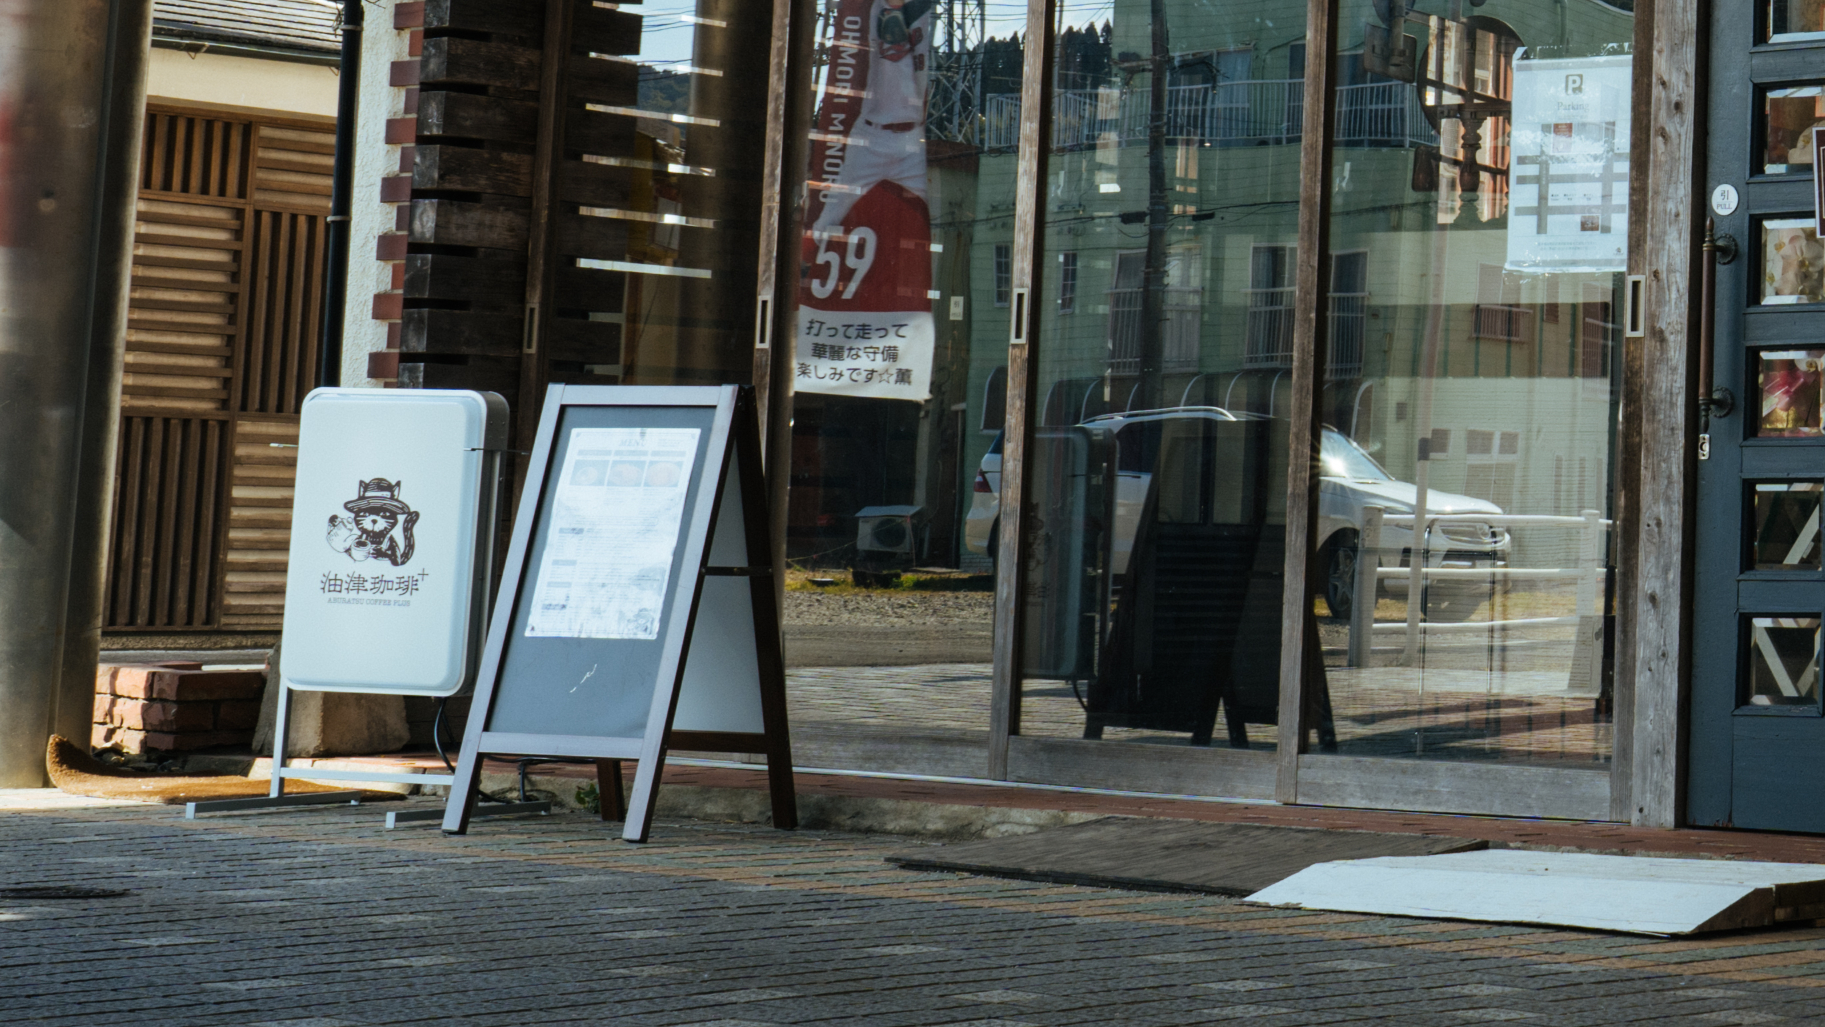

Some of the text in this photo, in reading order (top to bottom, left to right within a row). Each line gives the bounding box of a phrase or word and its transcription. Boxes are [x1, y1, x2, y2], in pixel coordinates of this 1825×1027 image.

[833, 16, 861, 103] OHMORI
[1557, 101, 1590, 113] Parking
[1720, 190, 1730, 200] 引
[811, 225, 877, 299] 59
[806, 318, 909, 340] 打って走って
[811, 342, 899, 363] 華麗な守備
[327, 597, 411, 607] ABURATSU COFFEE PLUS
